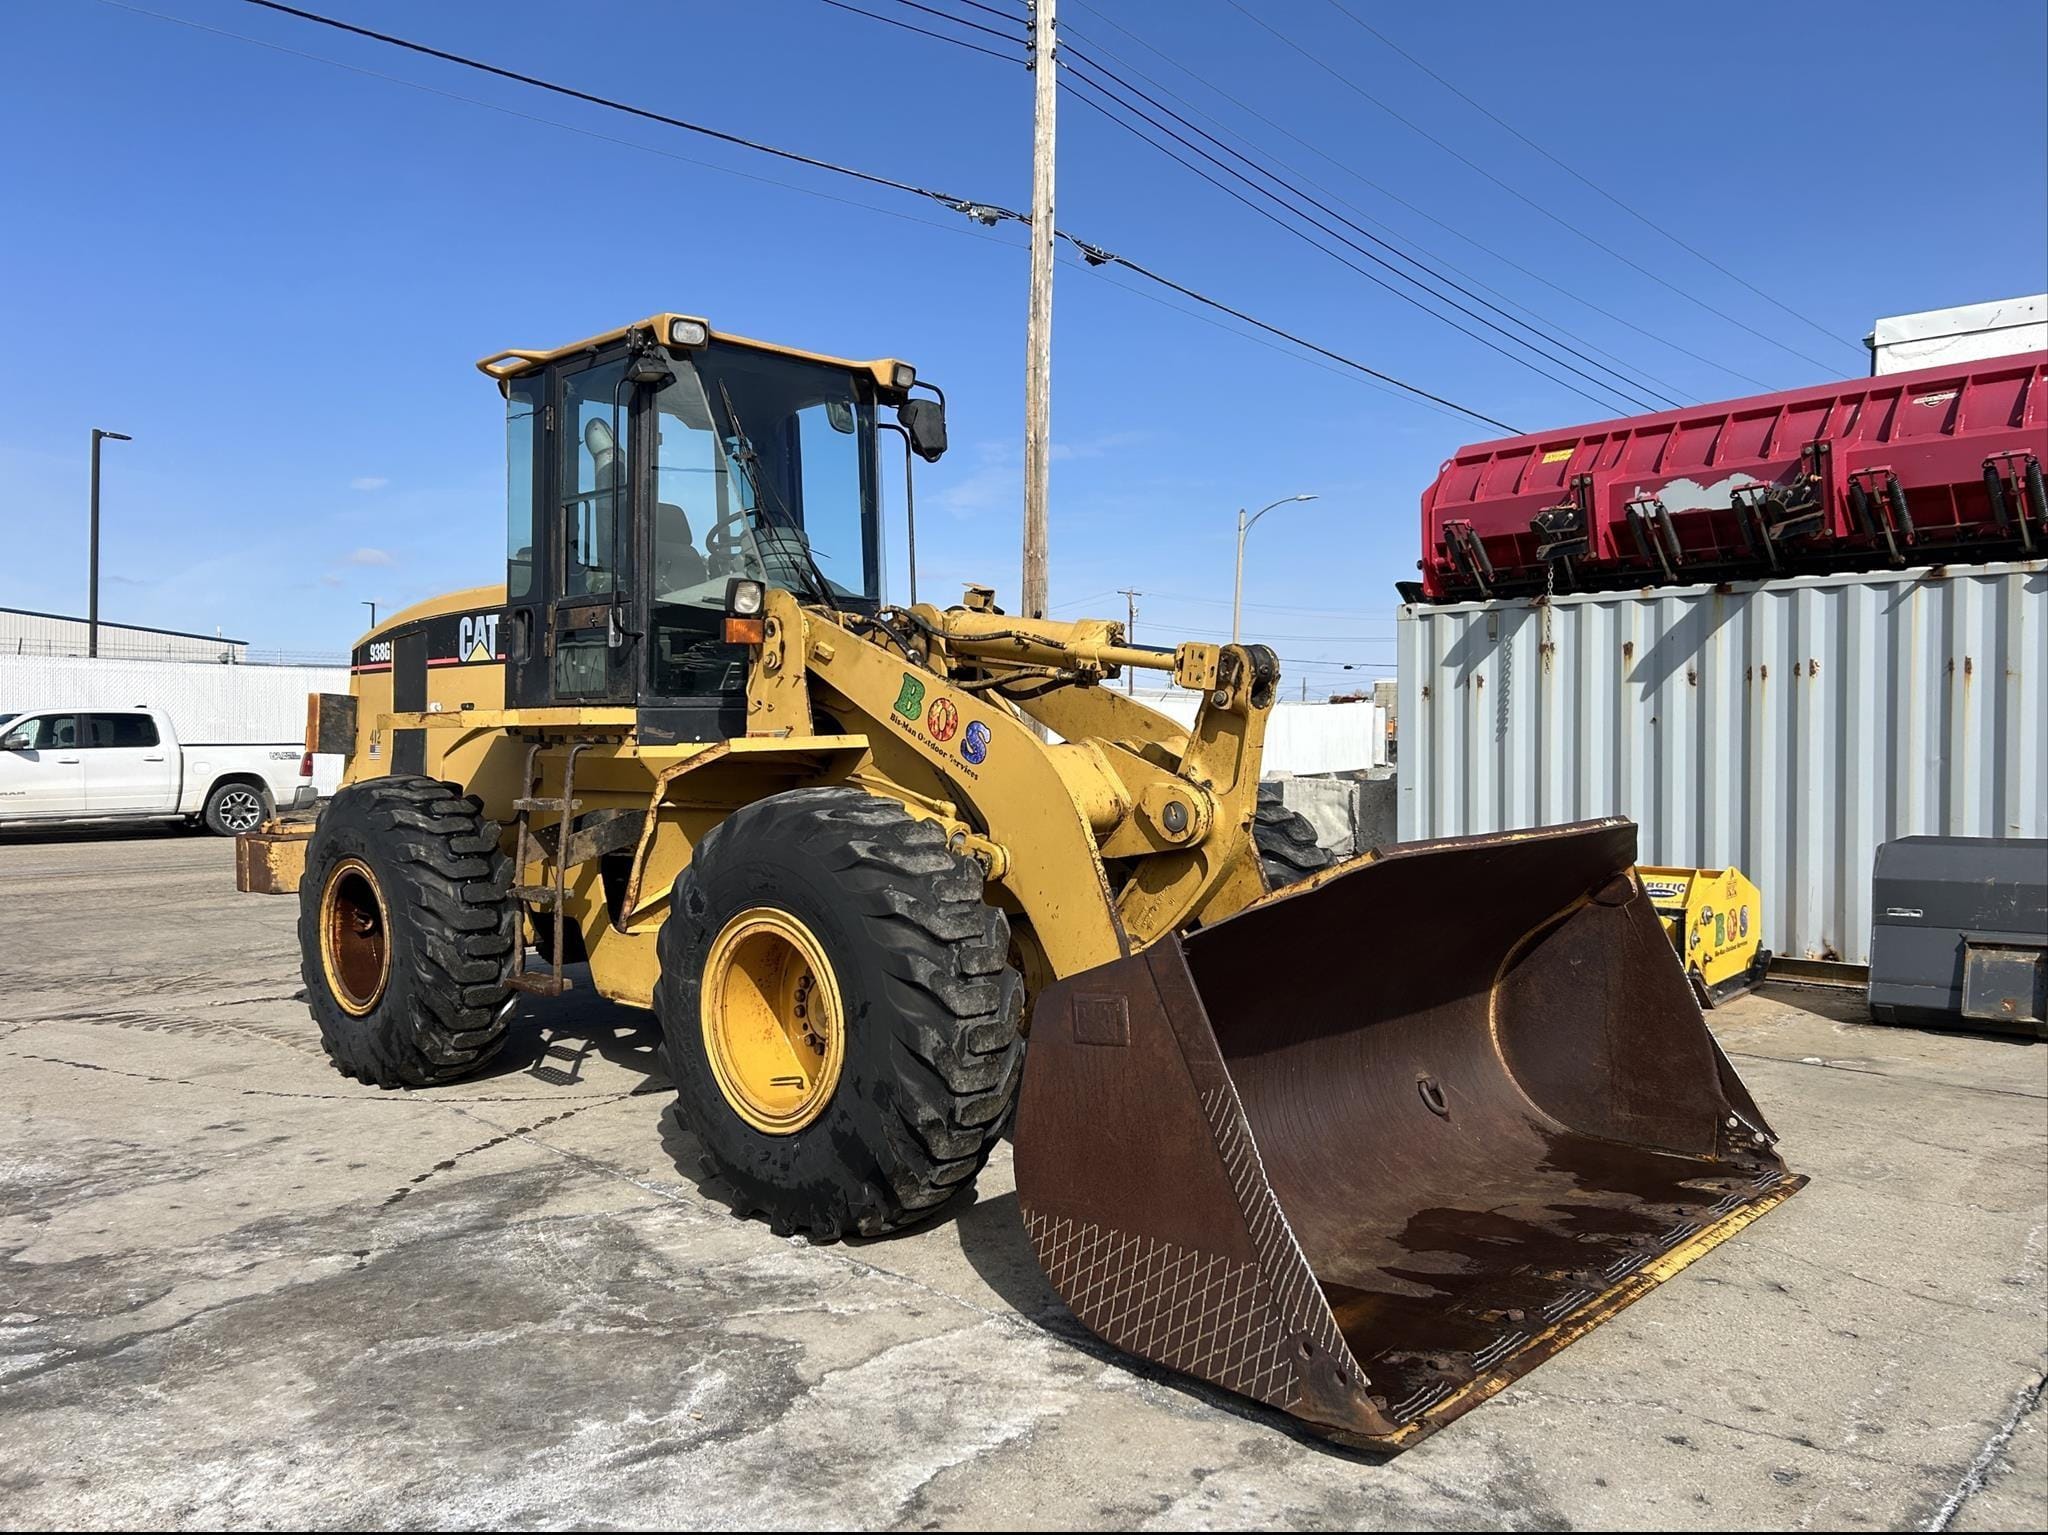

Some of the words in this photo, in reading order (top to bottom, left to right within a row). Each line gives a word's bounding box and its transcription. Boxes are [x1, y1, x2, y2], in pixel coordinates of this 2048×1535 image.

[370, 641, 391, 662] 938G
[459, 614, 500, 662] CAT
[889, 712, 917, 738] Bis-Man
[893, 671, 992, 765] BOS
[1715, 905, 1748, 947] BOS
